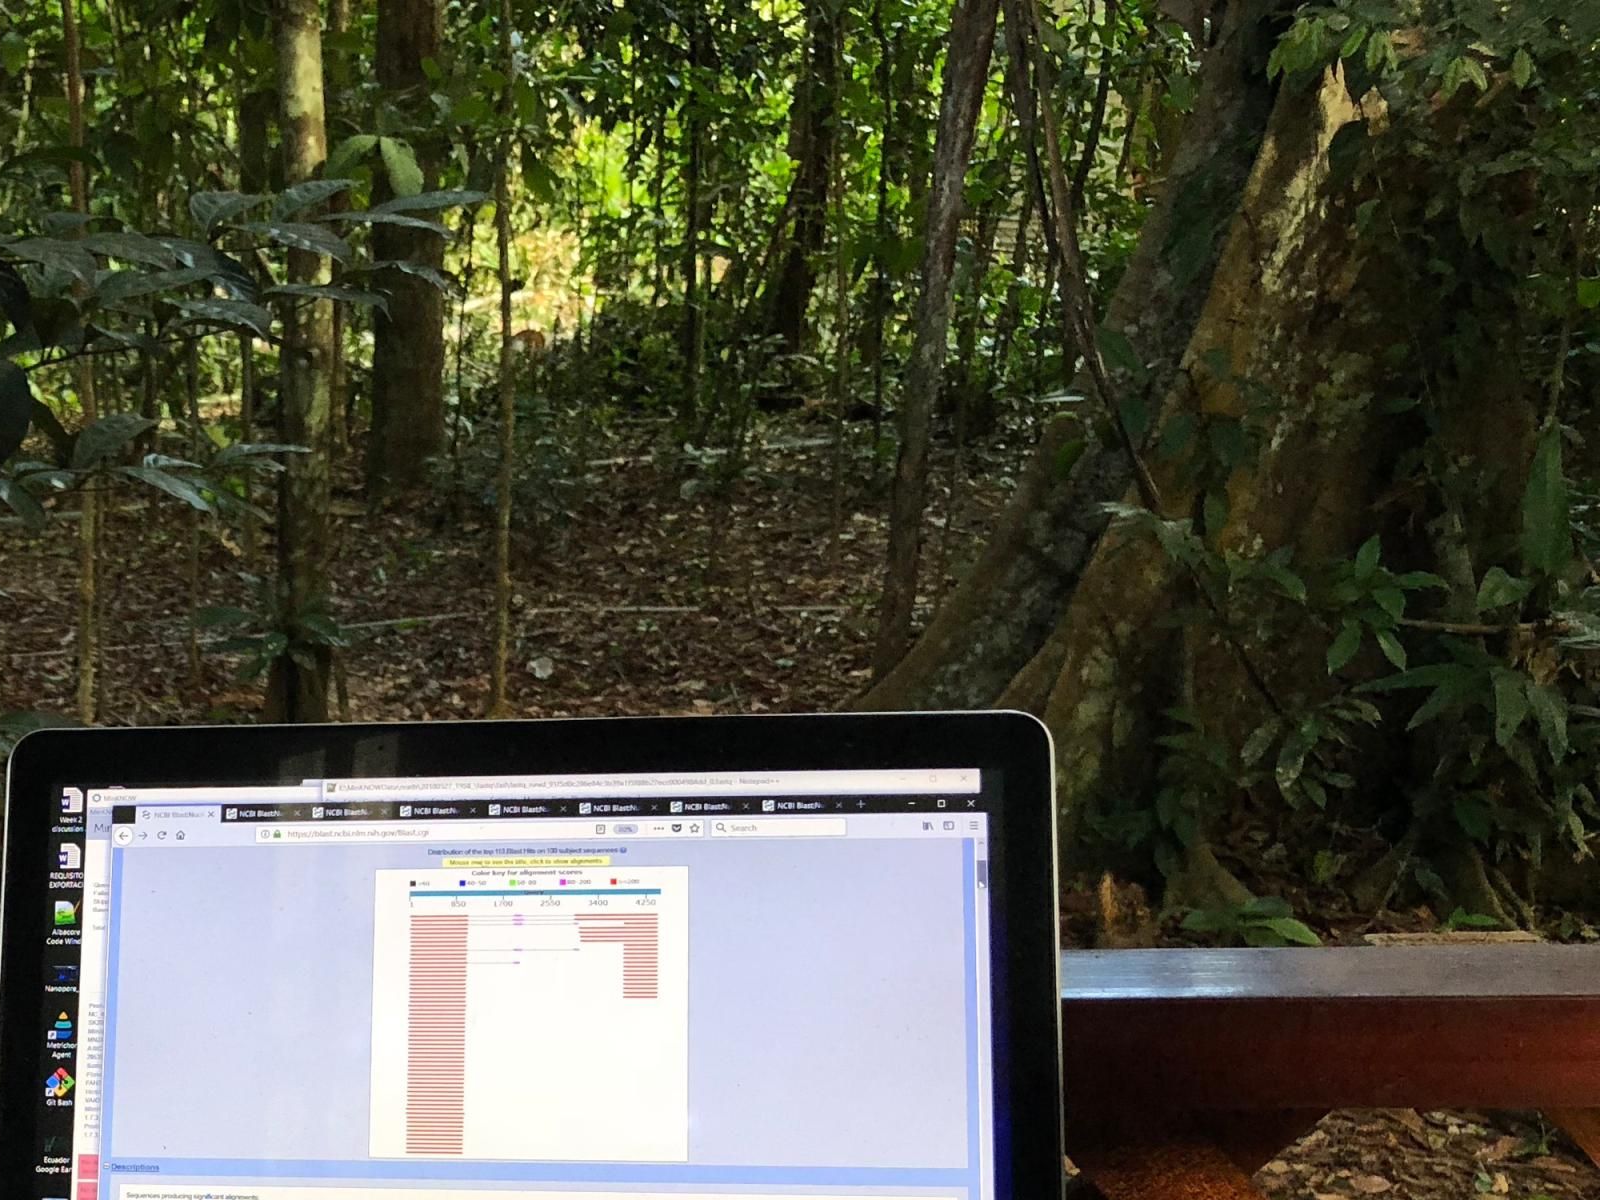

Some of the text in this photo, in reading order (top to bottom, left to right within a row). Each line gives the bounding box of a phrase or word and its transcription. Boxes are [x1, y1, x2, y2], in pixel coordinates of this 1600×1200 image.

[730, 823, 758, 833] Search
[471, 869, 490, 877] Color
[492, 869, 506, 878] key
[519, 869, 556, 877] alignment
[450, 900, 466, 908] 850
[494, 900, 513, 908] 1700
[588, 899, 609, 907] 3400
[45, 937, 64, 945] Code
[51, 1051, 72, 1060] Agent
[46, 1099, 73, 1107] Git Bash
[43, 1156, 71, 1164] Ecuador
[35, 1165, 60, 1175] Google
[110, 1162, 160, 1172] Descriptions
[126, 1191, 161, 1200] Sequences
[193, 1192, 224, 1200] significant
